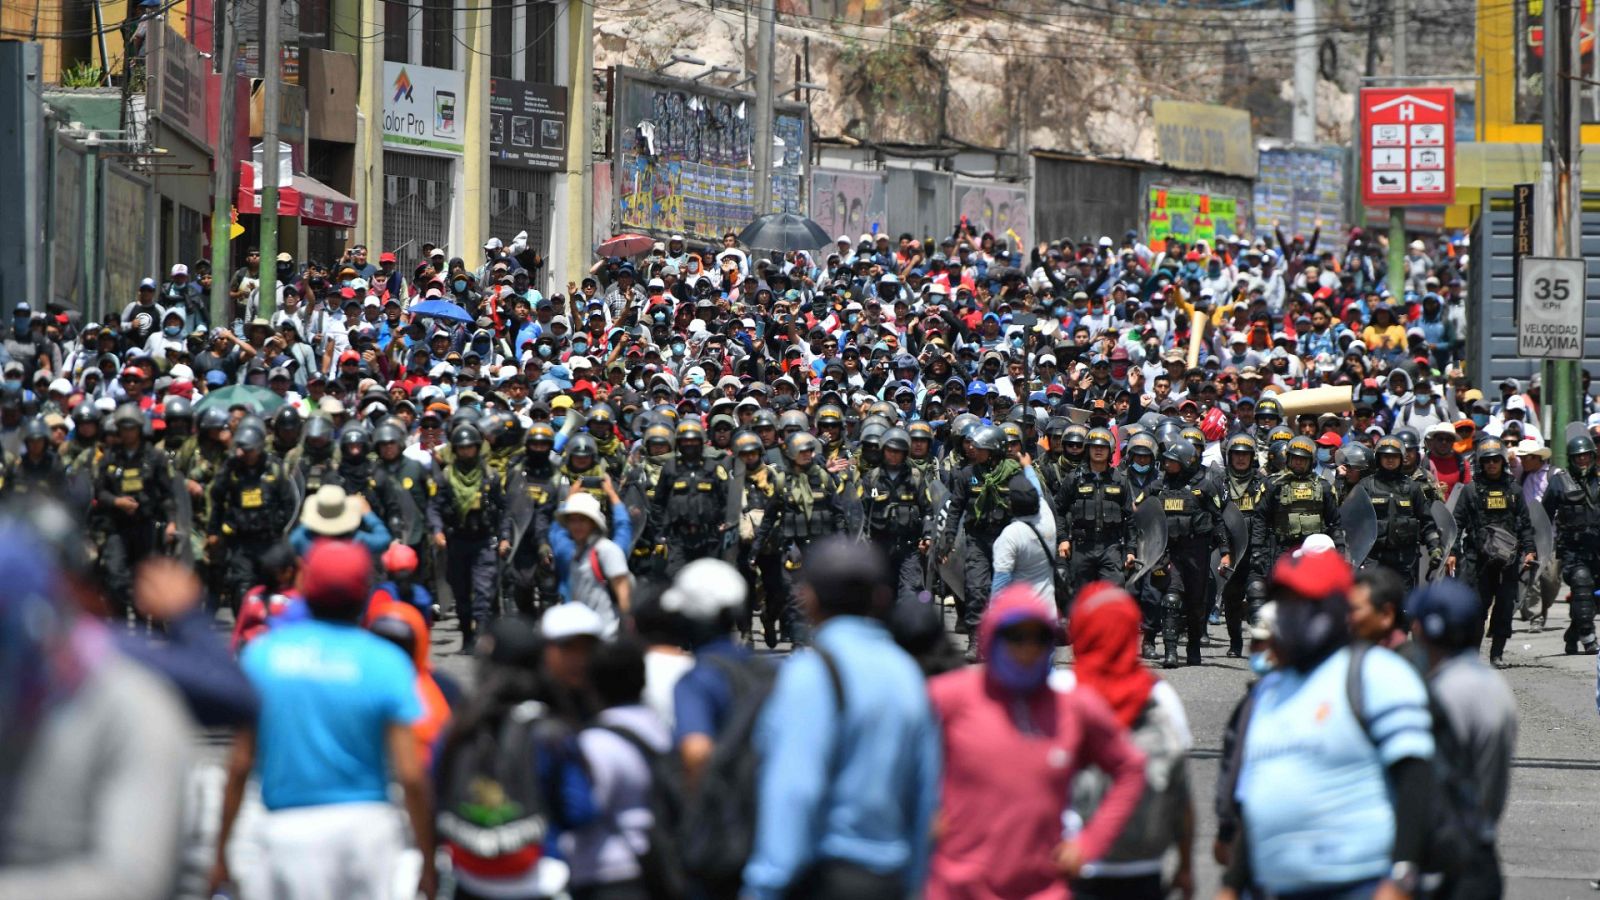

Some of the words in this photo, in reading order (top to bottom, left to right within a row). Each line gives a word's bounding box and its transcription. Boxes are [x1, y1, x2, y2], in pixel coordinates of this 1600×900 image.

[407, 112, 425, 135] Pro
[1519, 187, 1530, 257] PIER
[1534, 278, 1570, 301] 35
[1542, 302, 1561, 311] KPH
[1524, 324, 1578, 336] VELOCIDAD
